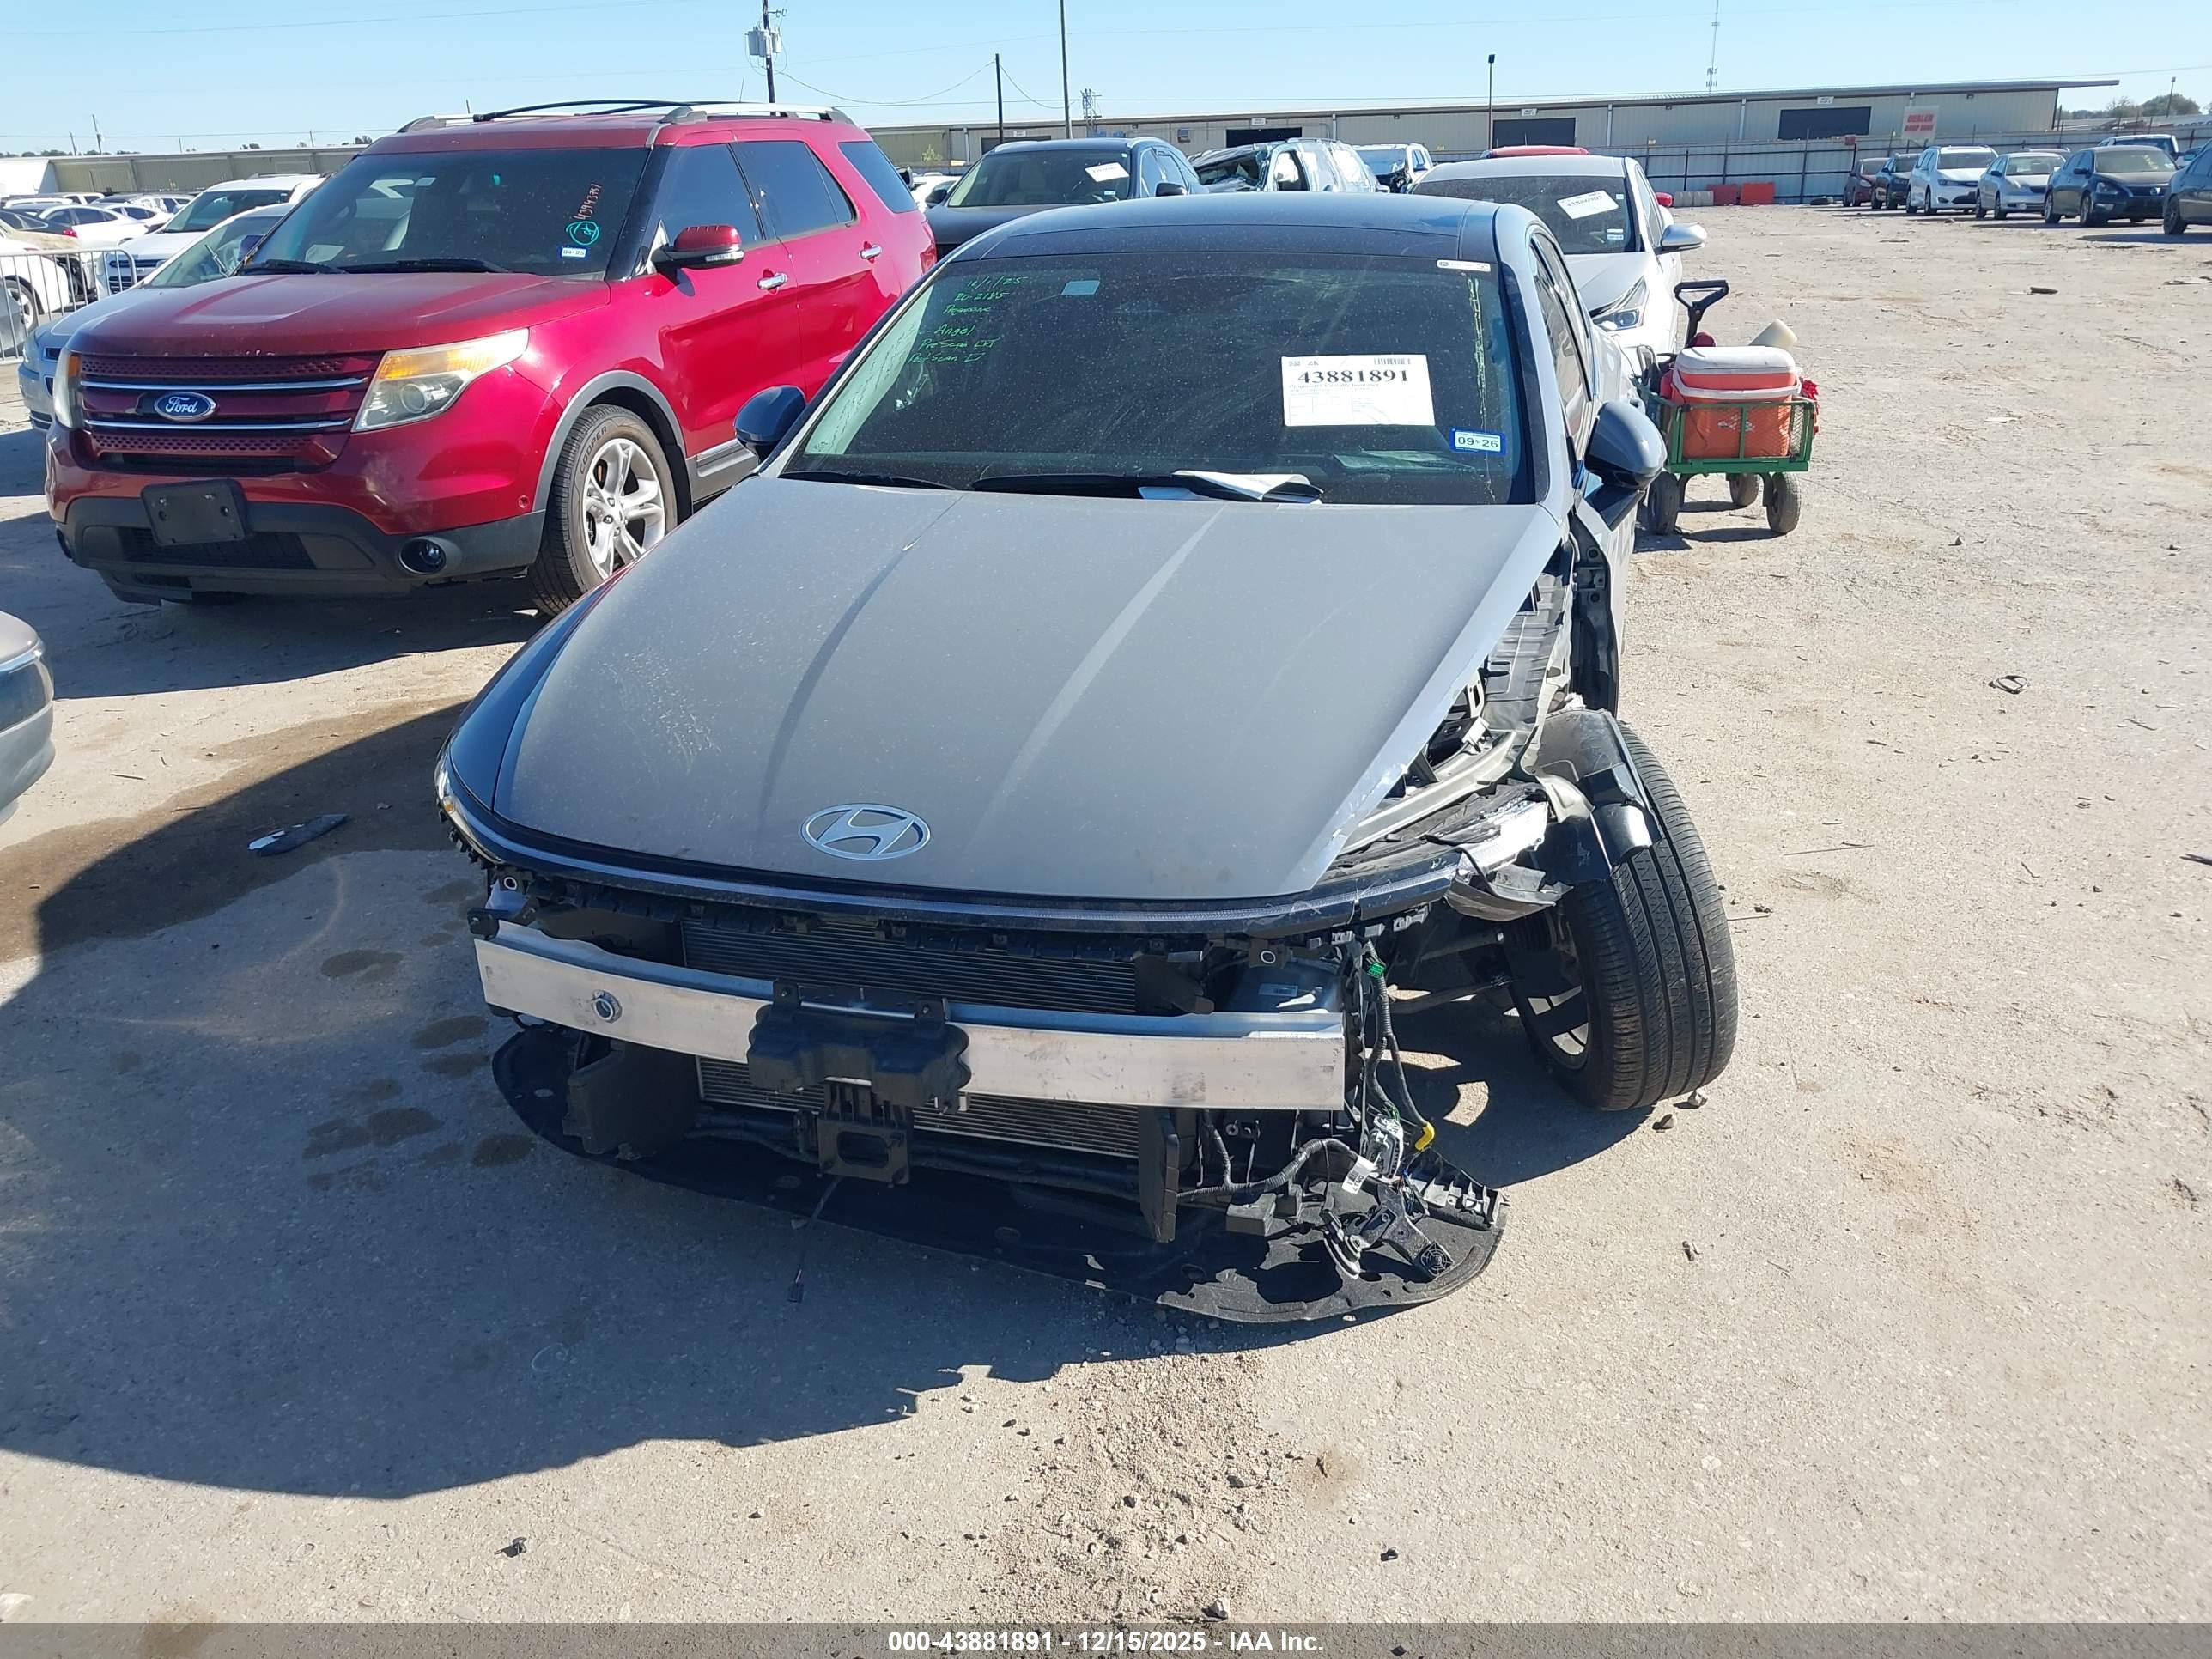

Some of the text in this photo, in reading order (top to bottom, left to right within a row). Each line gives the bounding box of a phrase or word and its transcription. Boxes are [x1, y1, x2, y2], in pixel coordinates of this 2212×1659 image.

[933, 323, 976, 337] Angel
[1297, 369, 1408, 384] 43881891
[165, 396, 198, 413] Ford
[580, 425, 607, 475] COOPER
